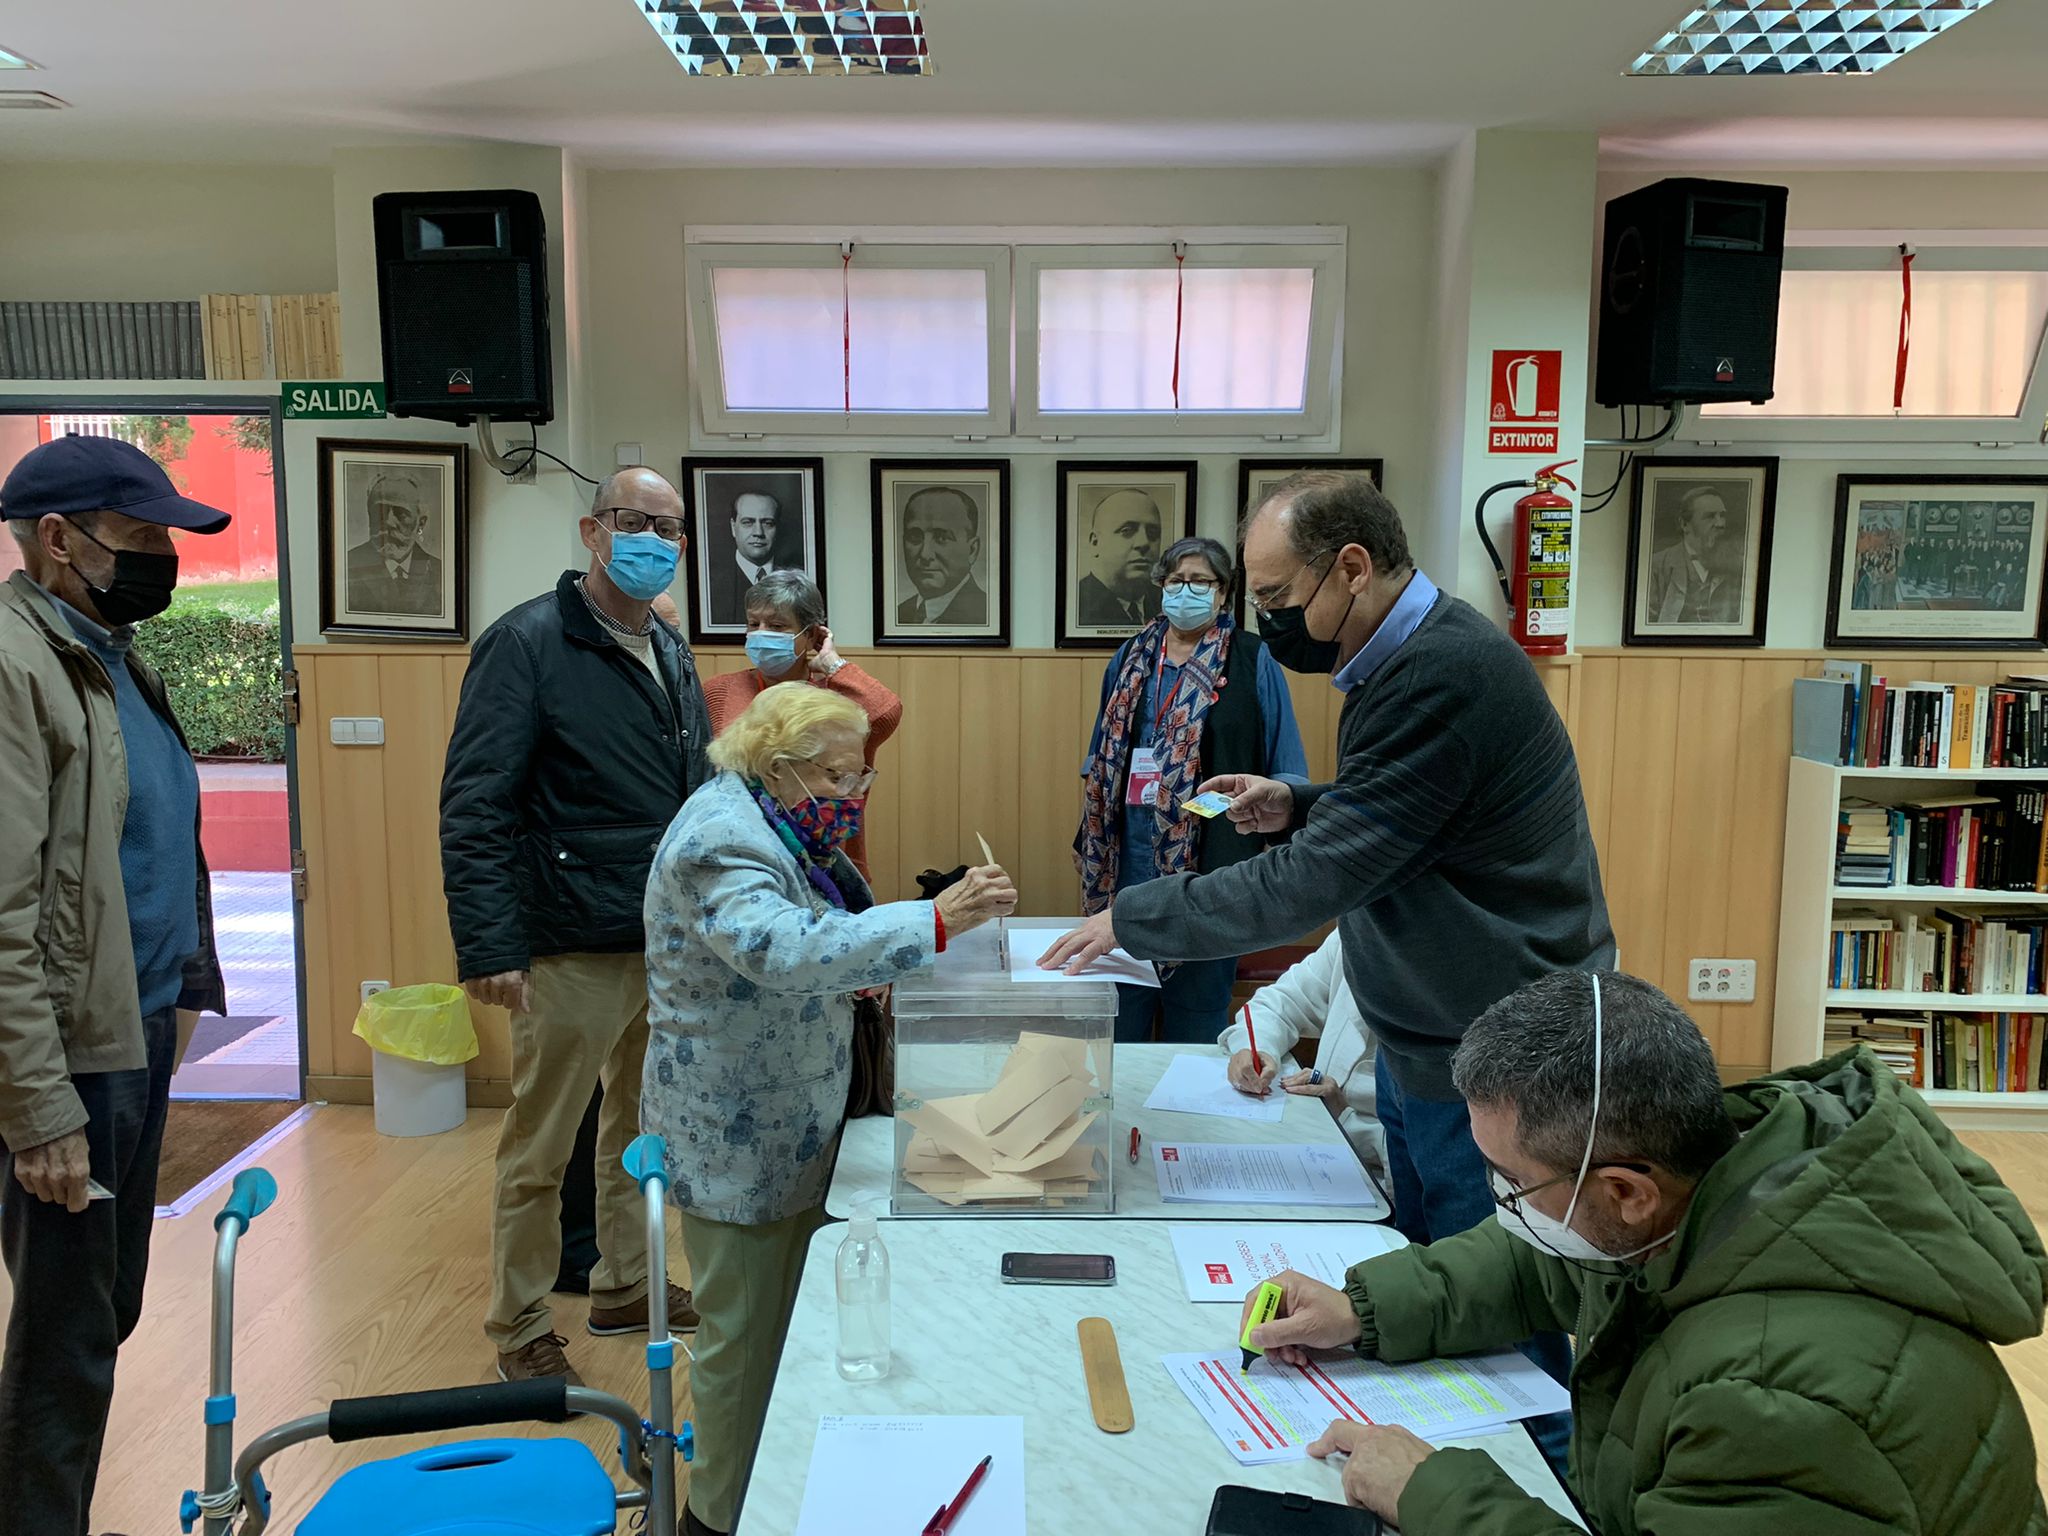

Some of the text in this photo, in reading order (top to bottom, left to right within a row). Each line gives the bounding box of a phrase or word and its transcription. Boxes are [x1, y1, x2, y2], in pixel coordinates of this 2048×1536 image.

[292, 389, 378, 411] SALIDA
[1493, 433, 1554, 447] EXTINTOR
[1235, 1240, 1259, 1272] CONGRESO
[1259, 1253, 1278, 1279] EGIONAL
